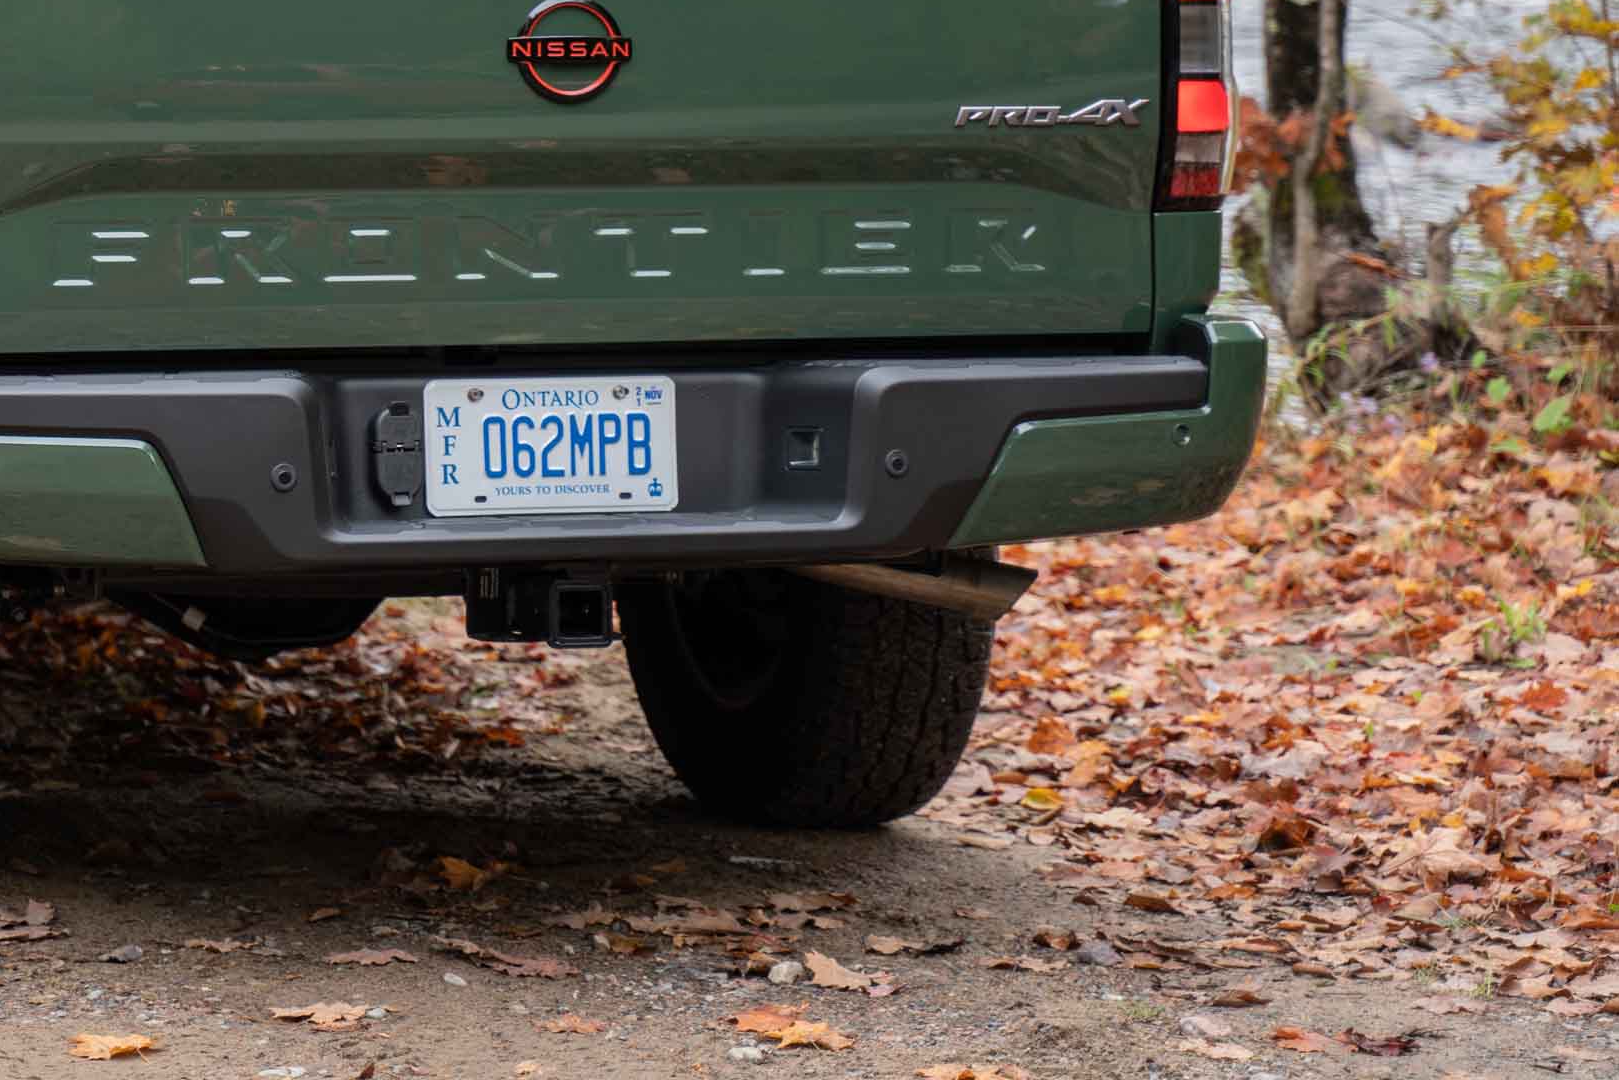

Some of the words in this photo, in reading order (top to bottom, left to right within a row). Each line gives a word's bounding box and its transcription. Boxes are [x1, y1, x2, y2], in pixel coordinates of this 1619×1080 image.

[511, 41, 630, 57] NISSAN
[954, 98, 1150, 127] PRO-4X
[52, 211, 1046, 287] FRONTIER
[482, 412, 653, 479] 062MPB
[494, 486, 532, 496] YOURS
[535, 485, 551, 495] TO
[554, 484, 610, 494] DISCOVER
